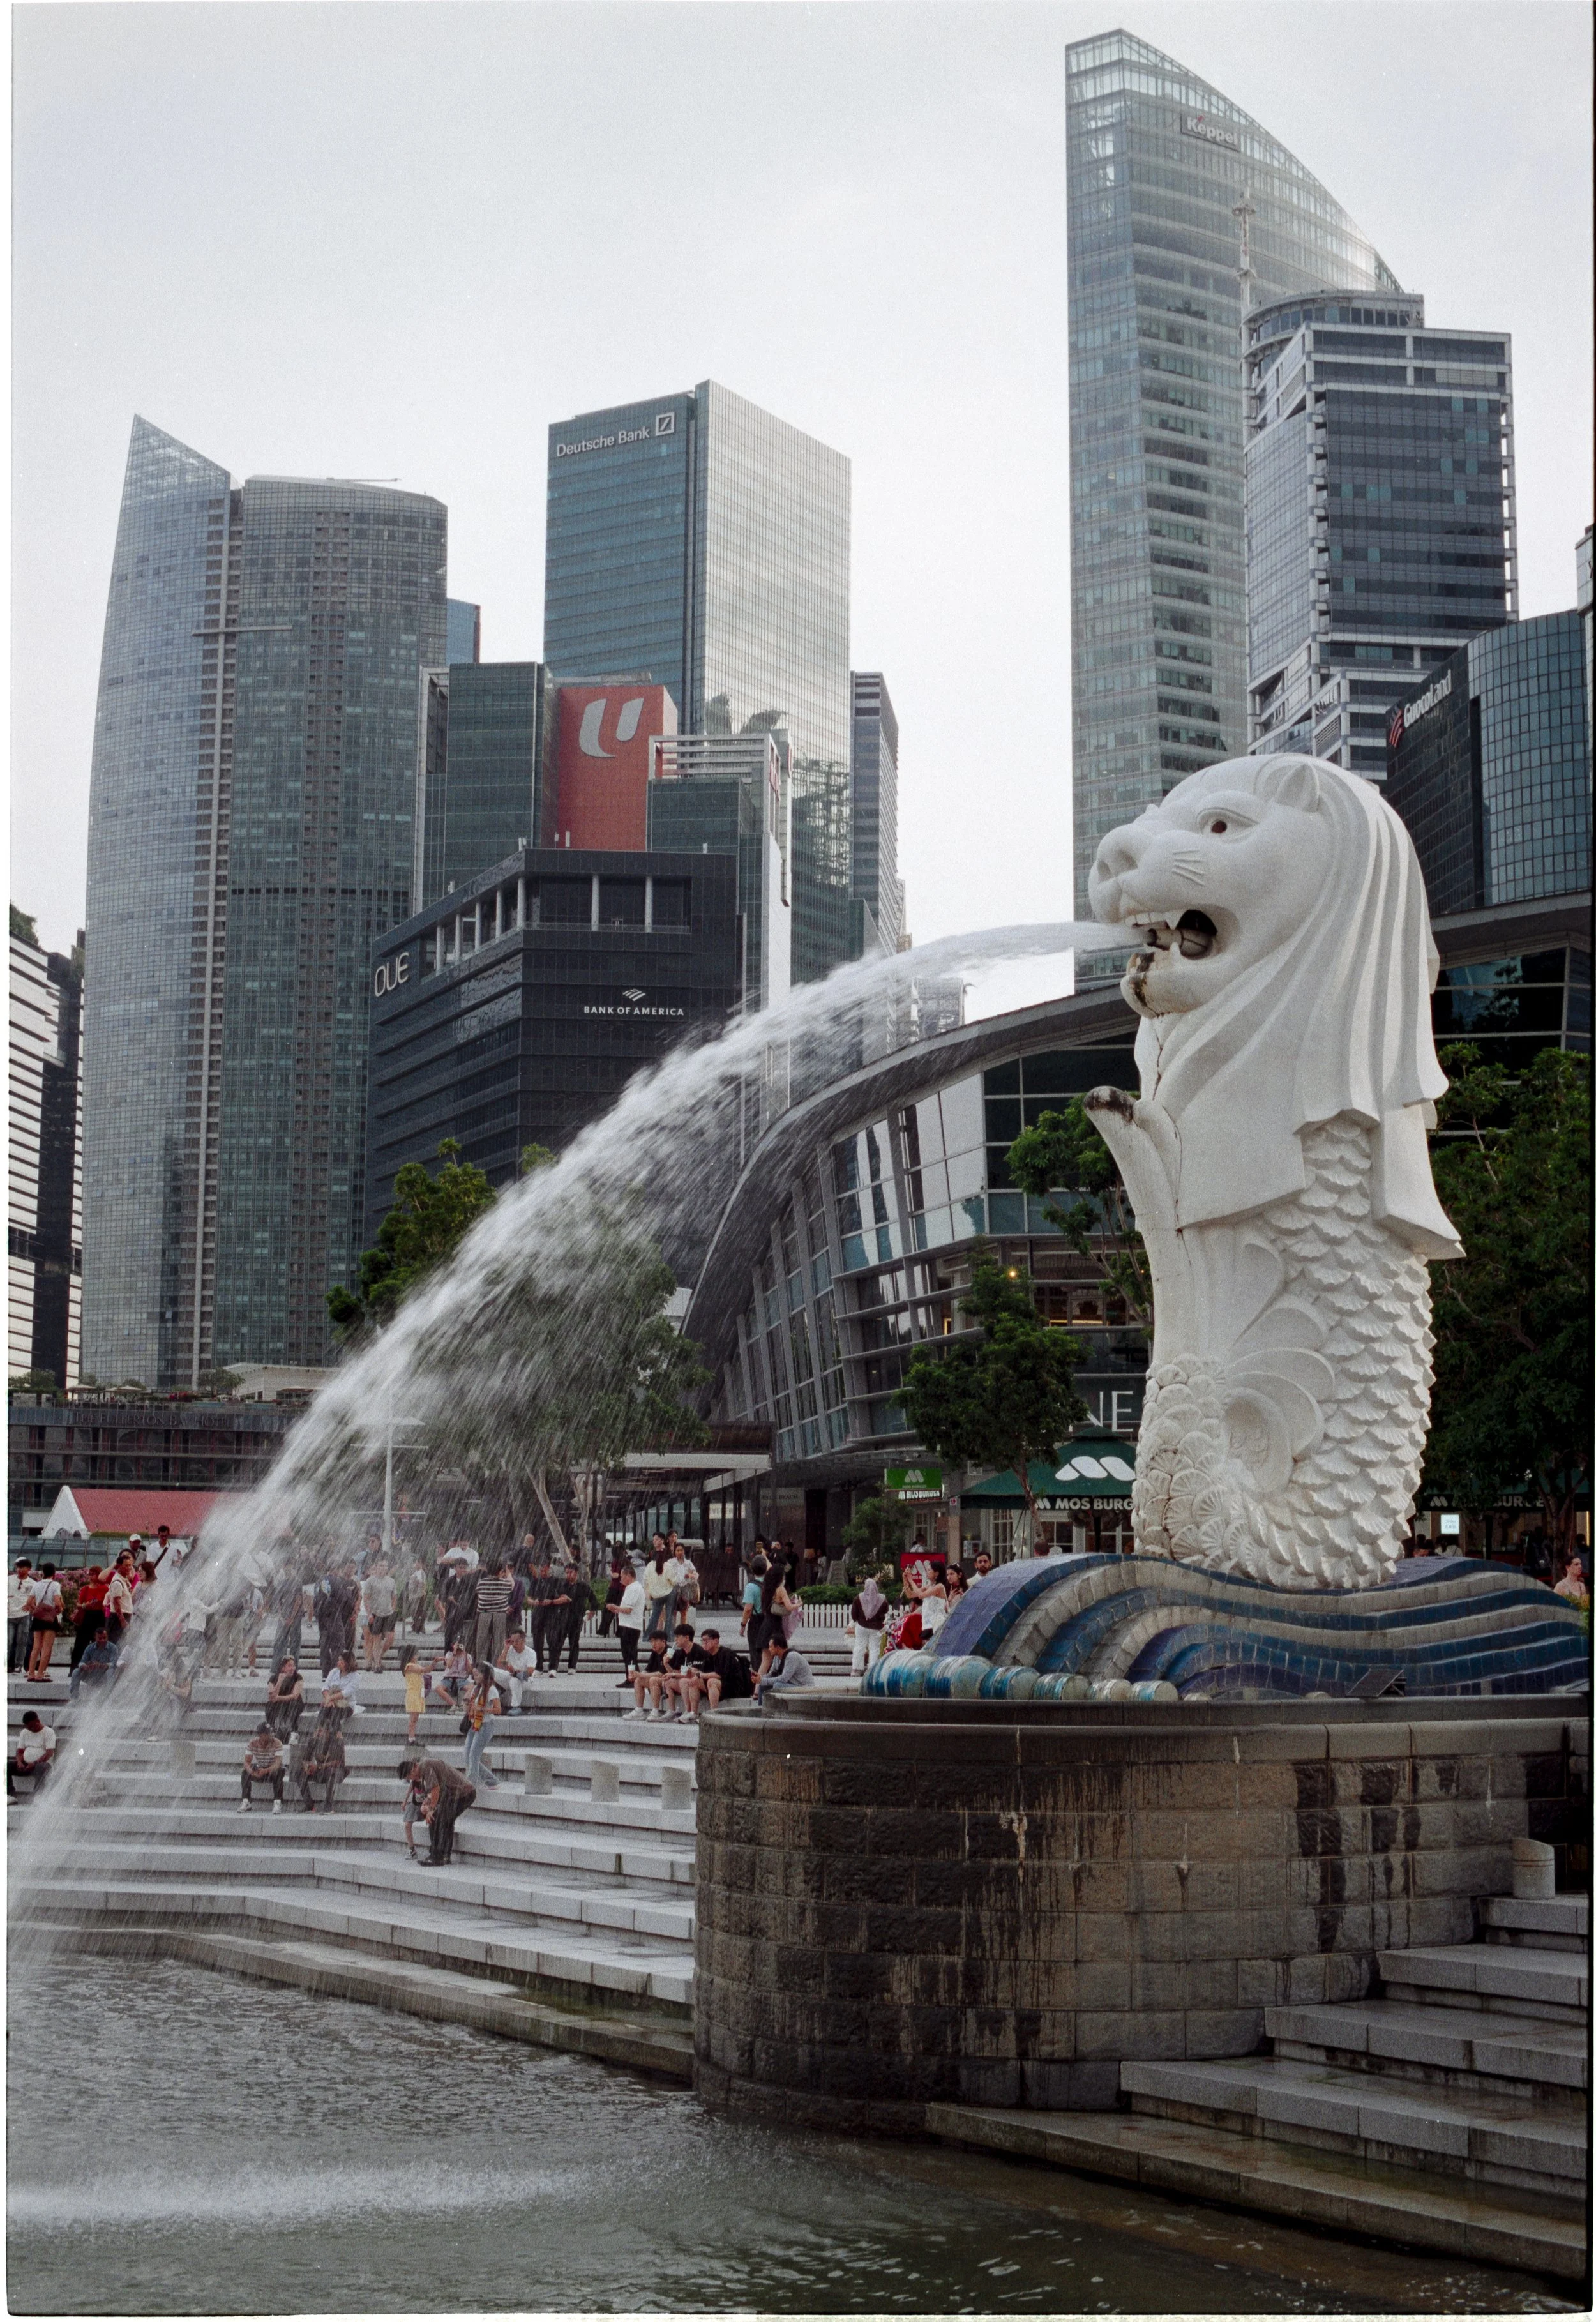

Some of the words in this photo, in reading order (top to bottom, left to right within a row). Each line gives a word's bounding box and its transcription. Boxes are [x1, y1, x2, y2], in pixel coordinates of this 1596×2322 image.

[1187, 116, 1238, 147] Keppel
[556, 435, 615, 457] Deutsche
[618, 426, 650, 444] Bank
[375, 952, 409, 997] OUE
[633, 1007, 684, 1016] AMERICA
[1055, 1498, 1090, 1510] MOS
